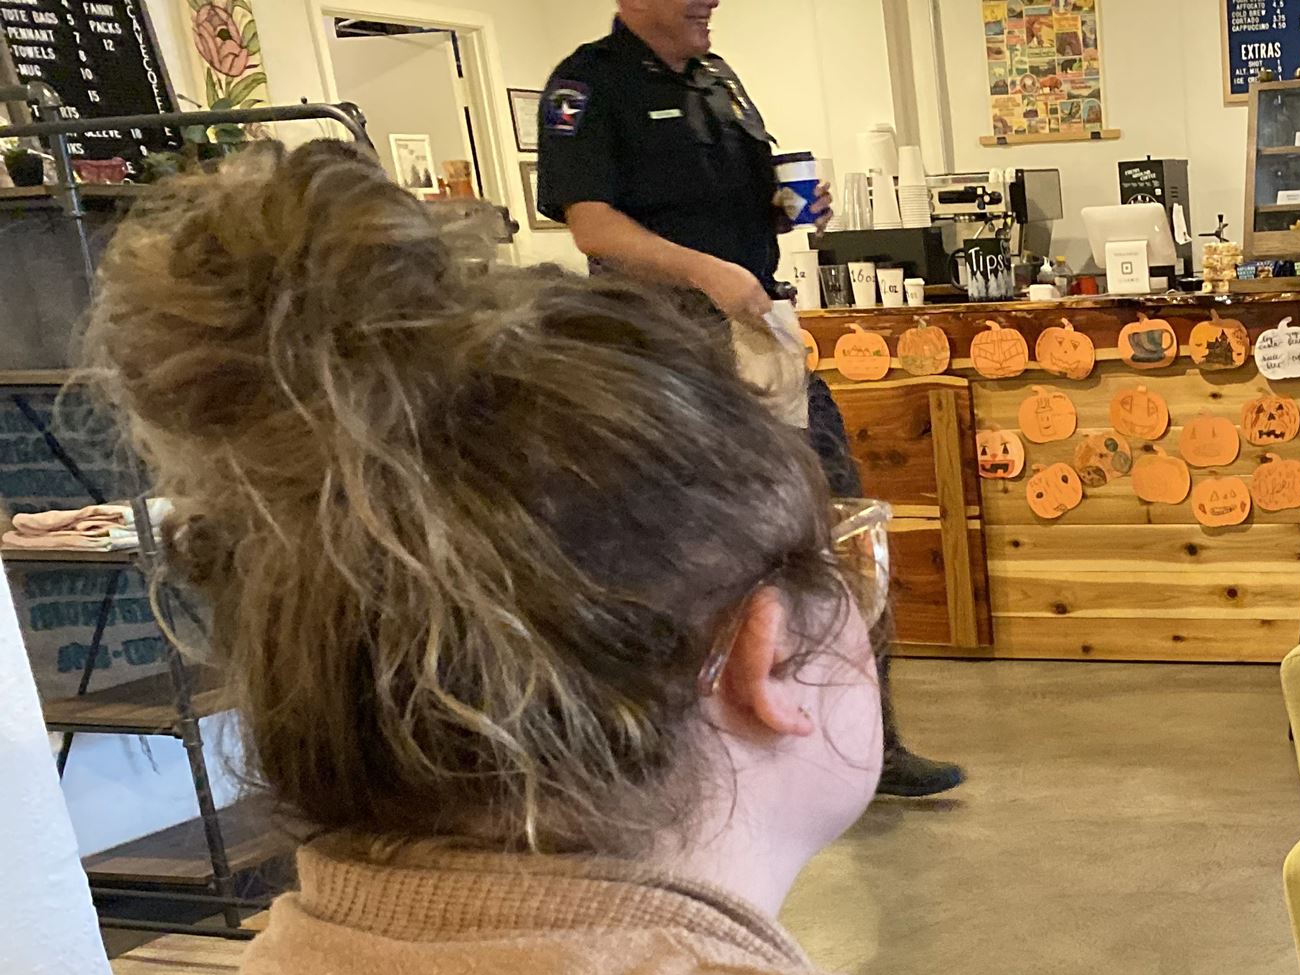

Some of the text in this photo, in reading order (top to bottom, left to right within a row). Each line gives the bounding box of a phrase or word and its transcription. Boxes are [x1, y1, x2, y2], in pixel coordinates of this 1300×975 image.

[88, 20, 122, 35] PACKS
[103, 38, 116, 52] 12
[1241, 42, 1281, 60] EXTRAS
[1248, 60, 1263, 68] SHOT
[968, 246, 1005, 280] Tips
